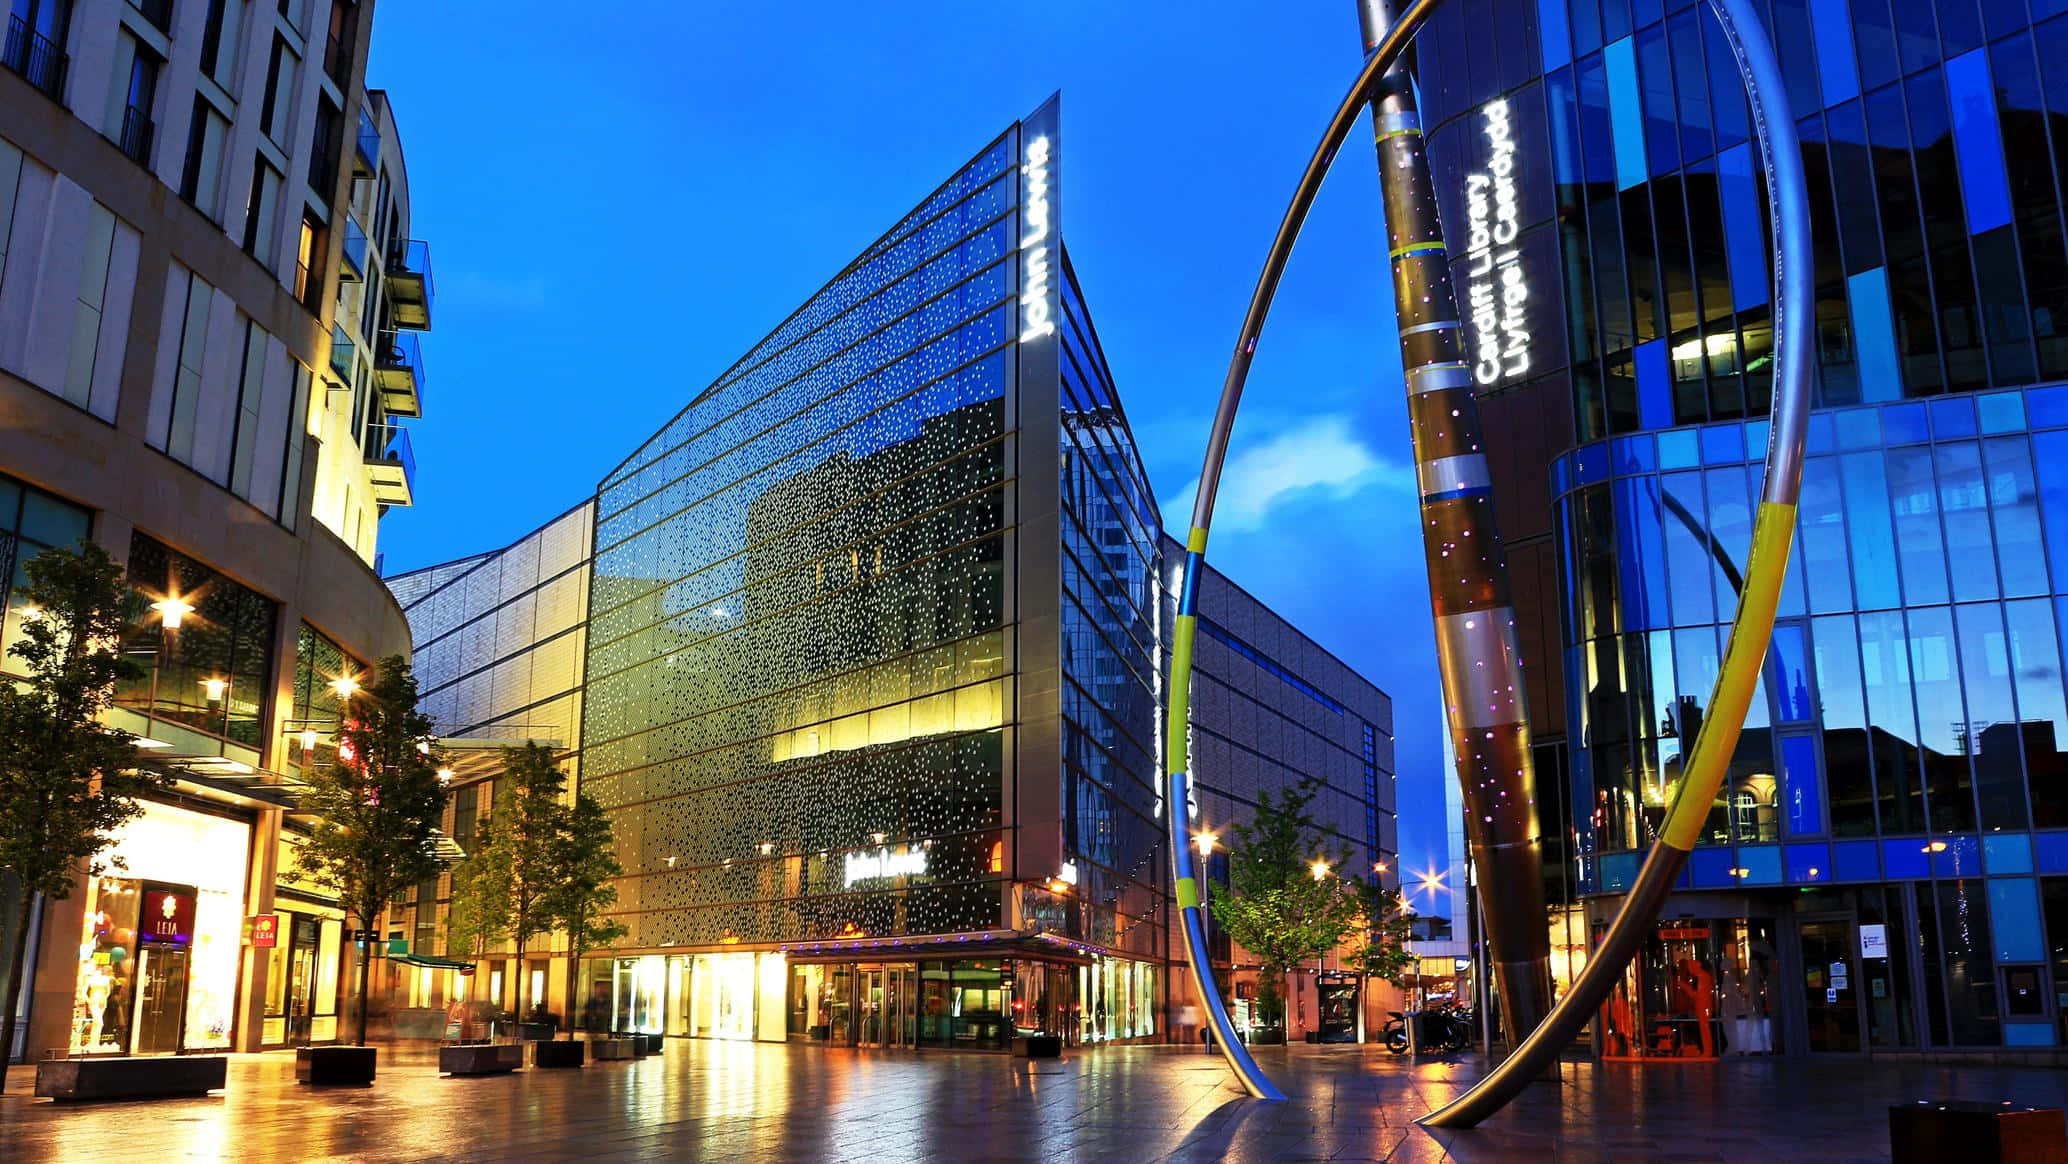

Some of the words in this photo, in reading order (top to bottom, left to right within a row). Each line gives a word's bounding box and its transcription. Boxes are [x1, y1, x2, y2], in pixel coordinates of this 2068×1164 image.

[1482, 98, 1517, 245] Caerdydd
[1466, 175, 1492, 278] Library
[1470, 284, 1500, 385] Cardiff
[156, 920, 177, 935] LEIA
[255, 931, 274, 939] LEIA
